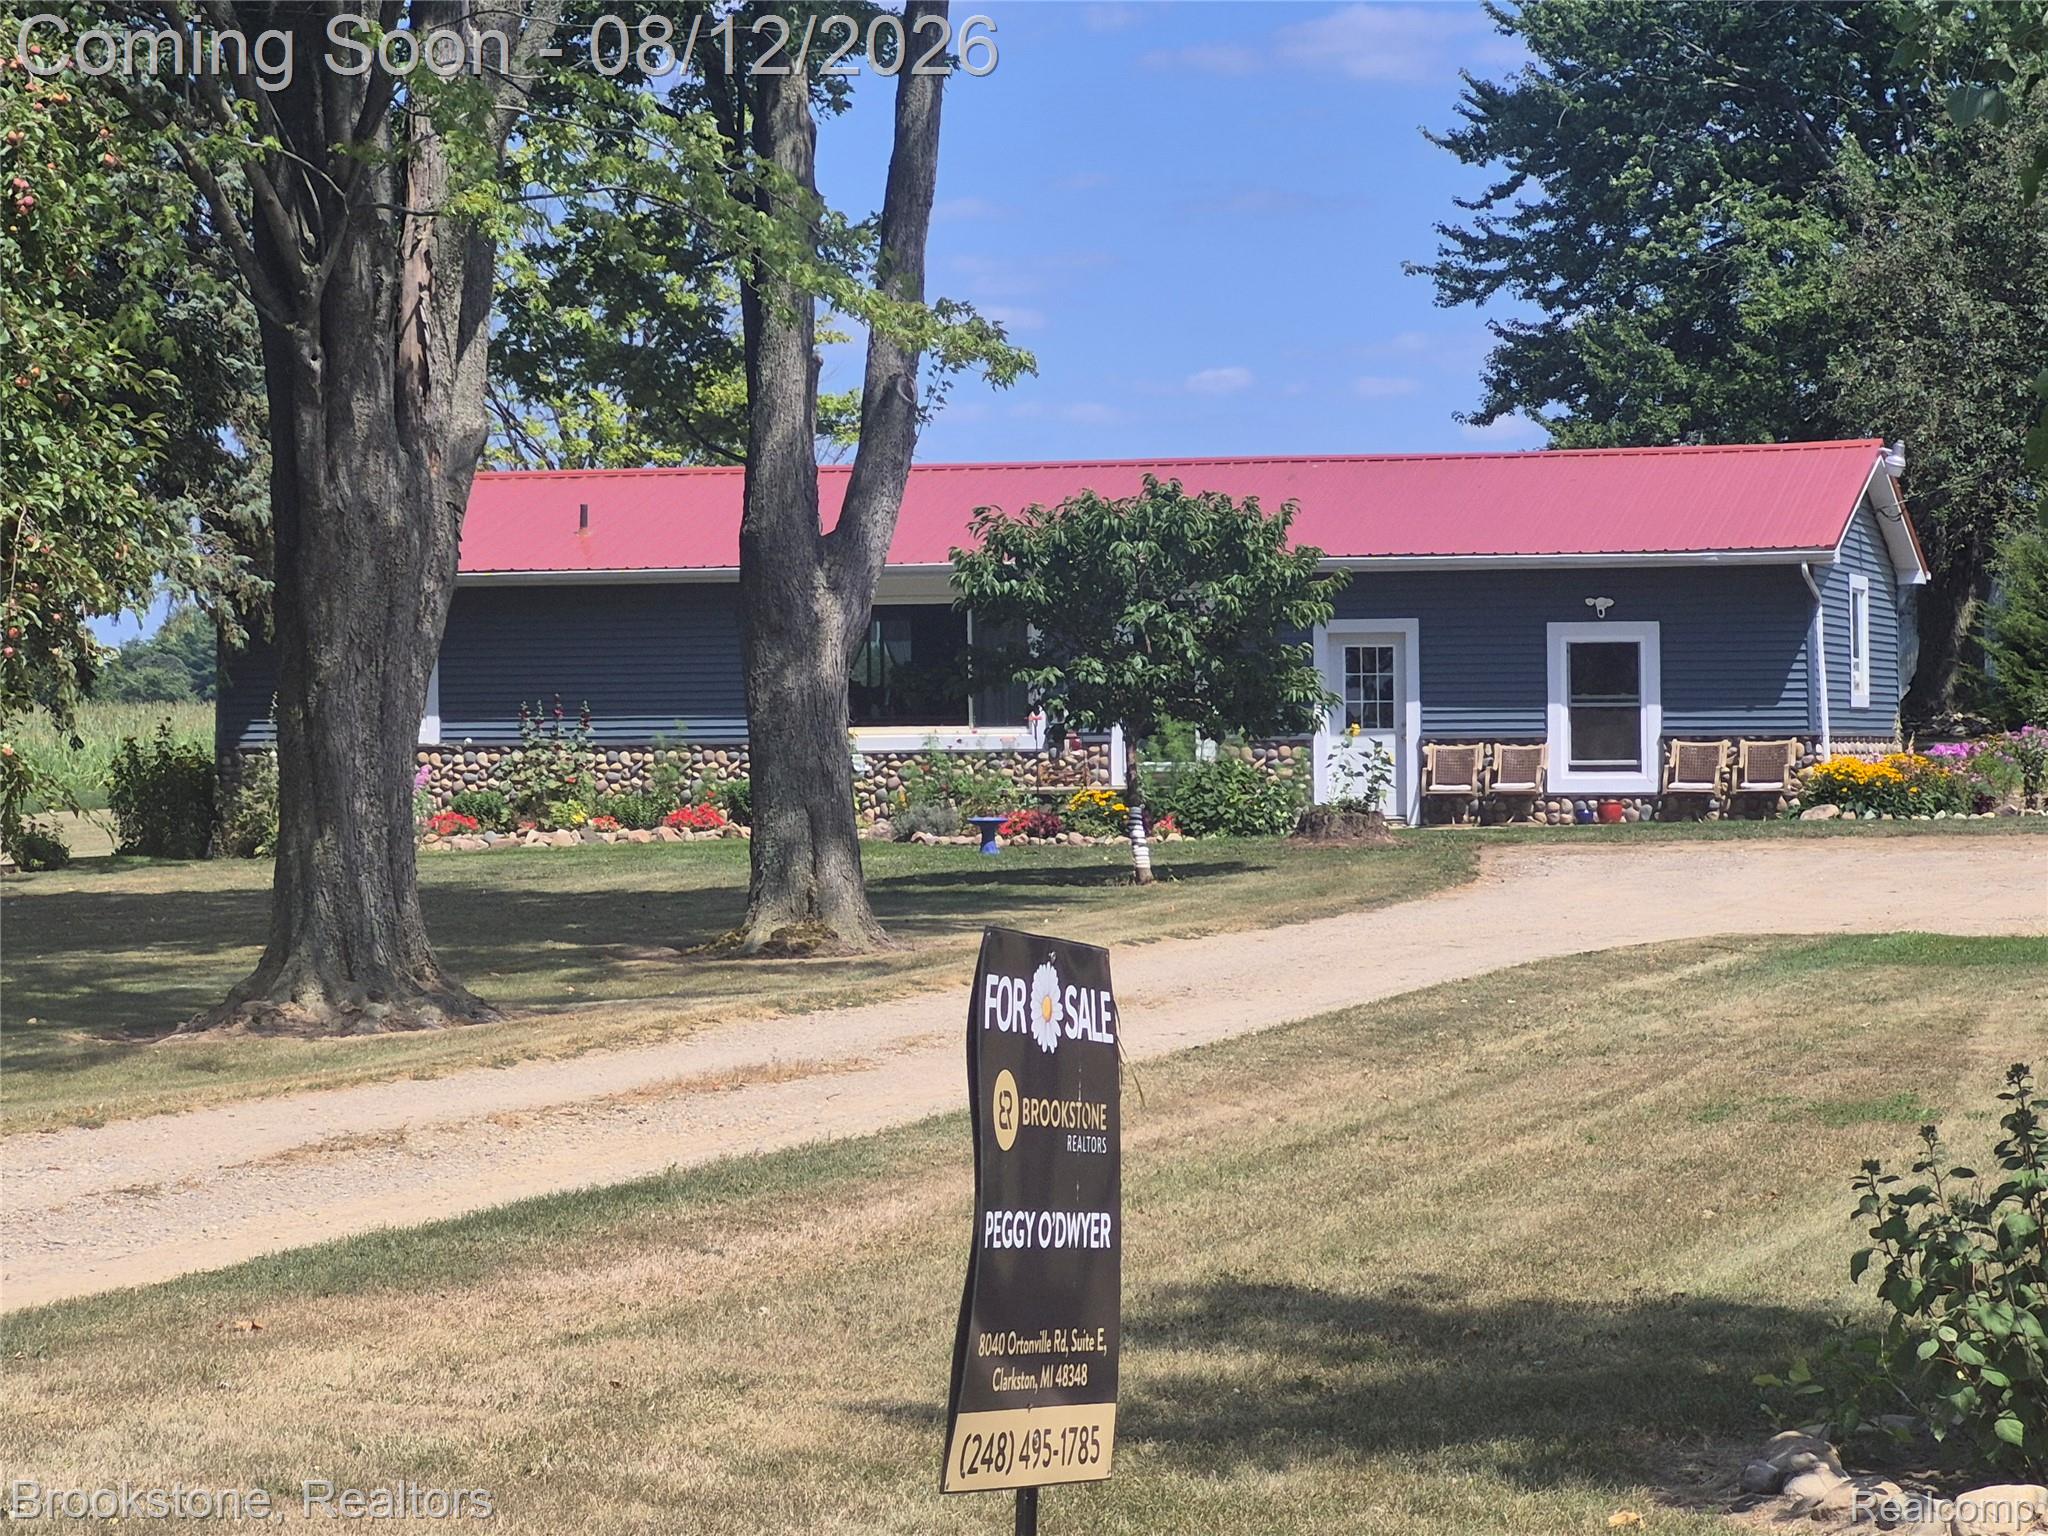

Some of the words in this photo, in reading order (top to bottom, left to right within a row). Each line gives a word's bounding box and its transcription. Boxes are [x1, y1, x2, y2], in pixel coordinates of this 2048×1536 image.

[984, 973, 1027, 1034] FOR
[1065, 984, 1114, 1044] SALE
[1022, 1097, 1107, 1130] BROOKSTONE
[1067, 1134, 1107, 1154] REALTORS
[984, 1210, 1035, 1248] PEGGY
[1038, 1211, 1112, 1249] O'DWYER
[978, 1332, 1005, 1356] 8040
[1007, 1330, 1052, 1355] Ortonville
[1053, 1328, 1069, 1358] Rd,
[1071, 1328, 1095, 1351] Suite
[1097, 1328, 1107, 1356] E,
[992, 1365, 1038, 1394] Clarkston,
[1040, 1364, 1054, 1387] MI
[1055, 1363, 1088, 1387] 48348
[960, 1430, 1016, 1479] (248)
[1019, 1425, 1100, 1470] 495-1785
